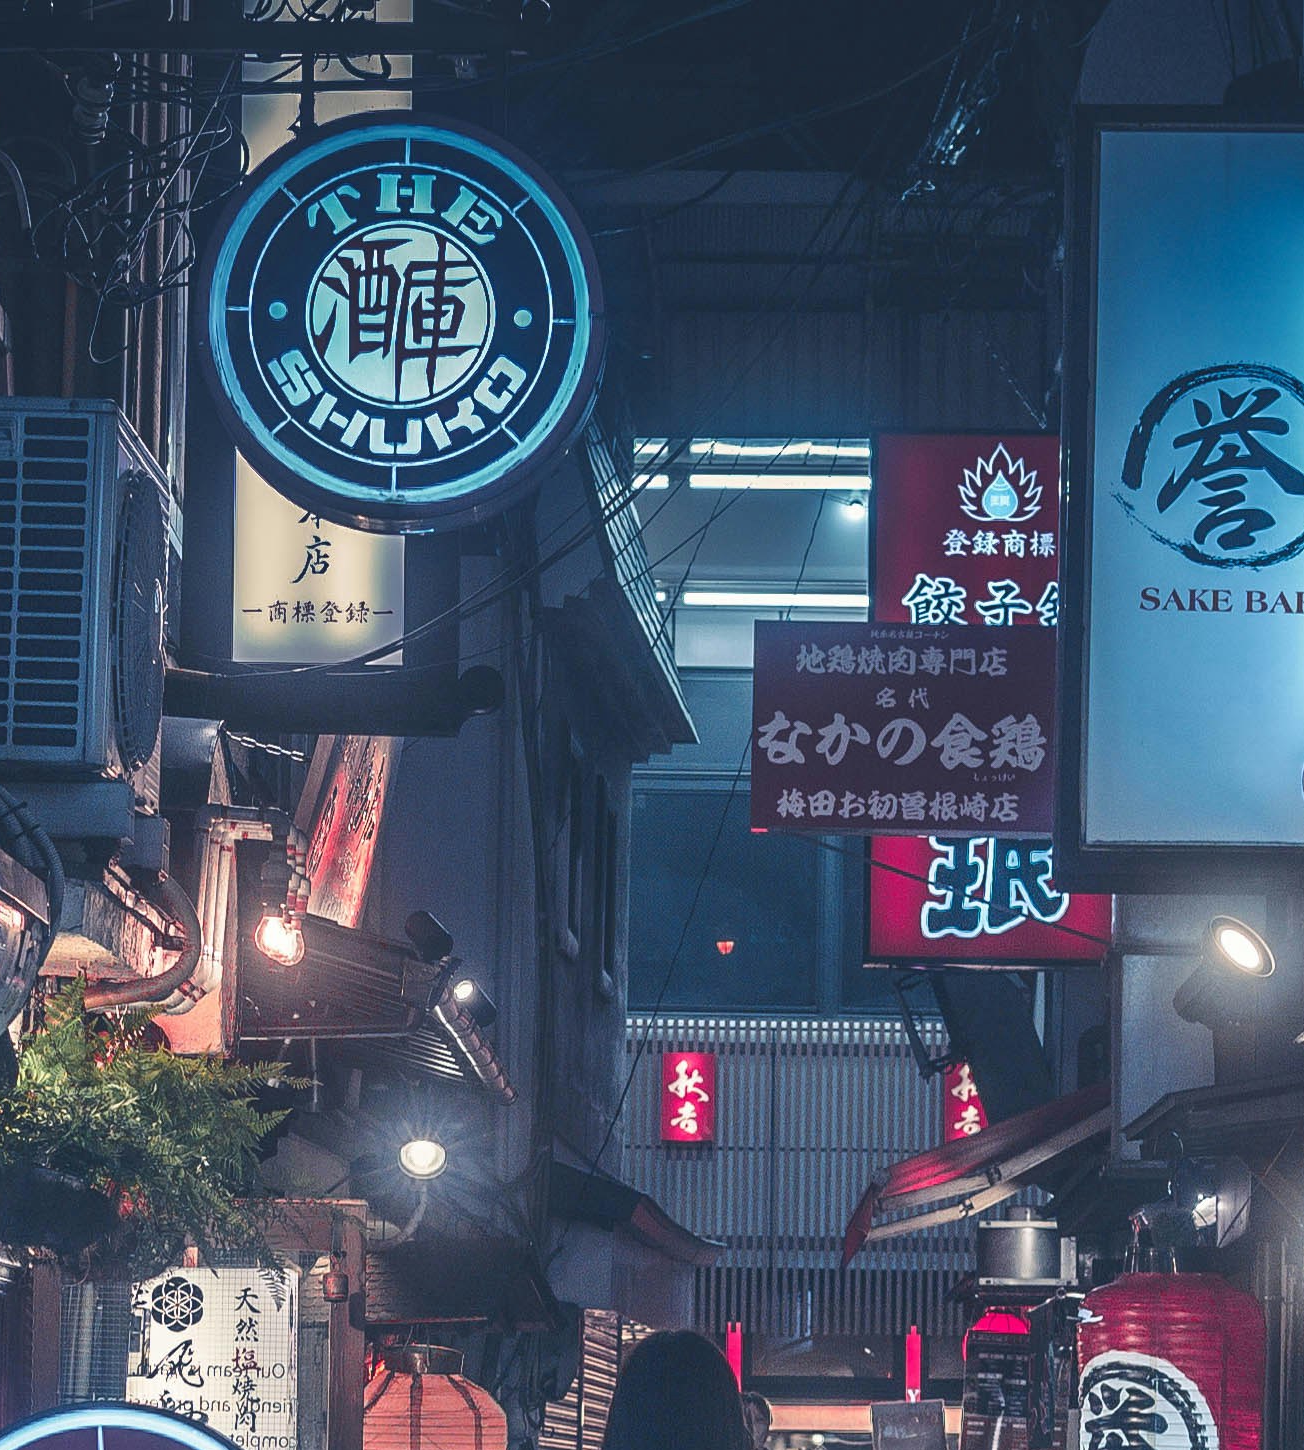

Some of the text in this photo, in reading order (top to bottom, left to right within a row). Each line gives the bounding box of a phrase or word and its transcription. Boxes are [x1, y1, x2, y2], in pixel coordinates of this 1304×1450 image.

[308, 173, 504, 245] THE
[267, 350, 527, 455] SHUKO
[290, 511, 332, 584] 店
[943, 528, 1057, 558] 登録商標
[1139, 586, 1233, 613] SAKE
[796, 643, 1008, 677] 地鶏焼肉専門店
[875, 687, 930, 710] 名代
[757, 710, 1047, 773] なかの食鶏
